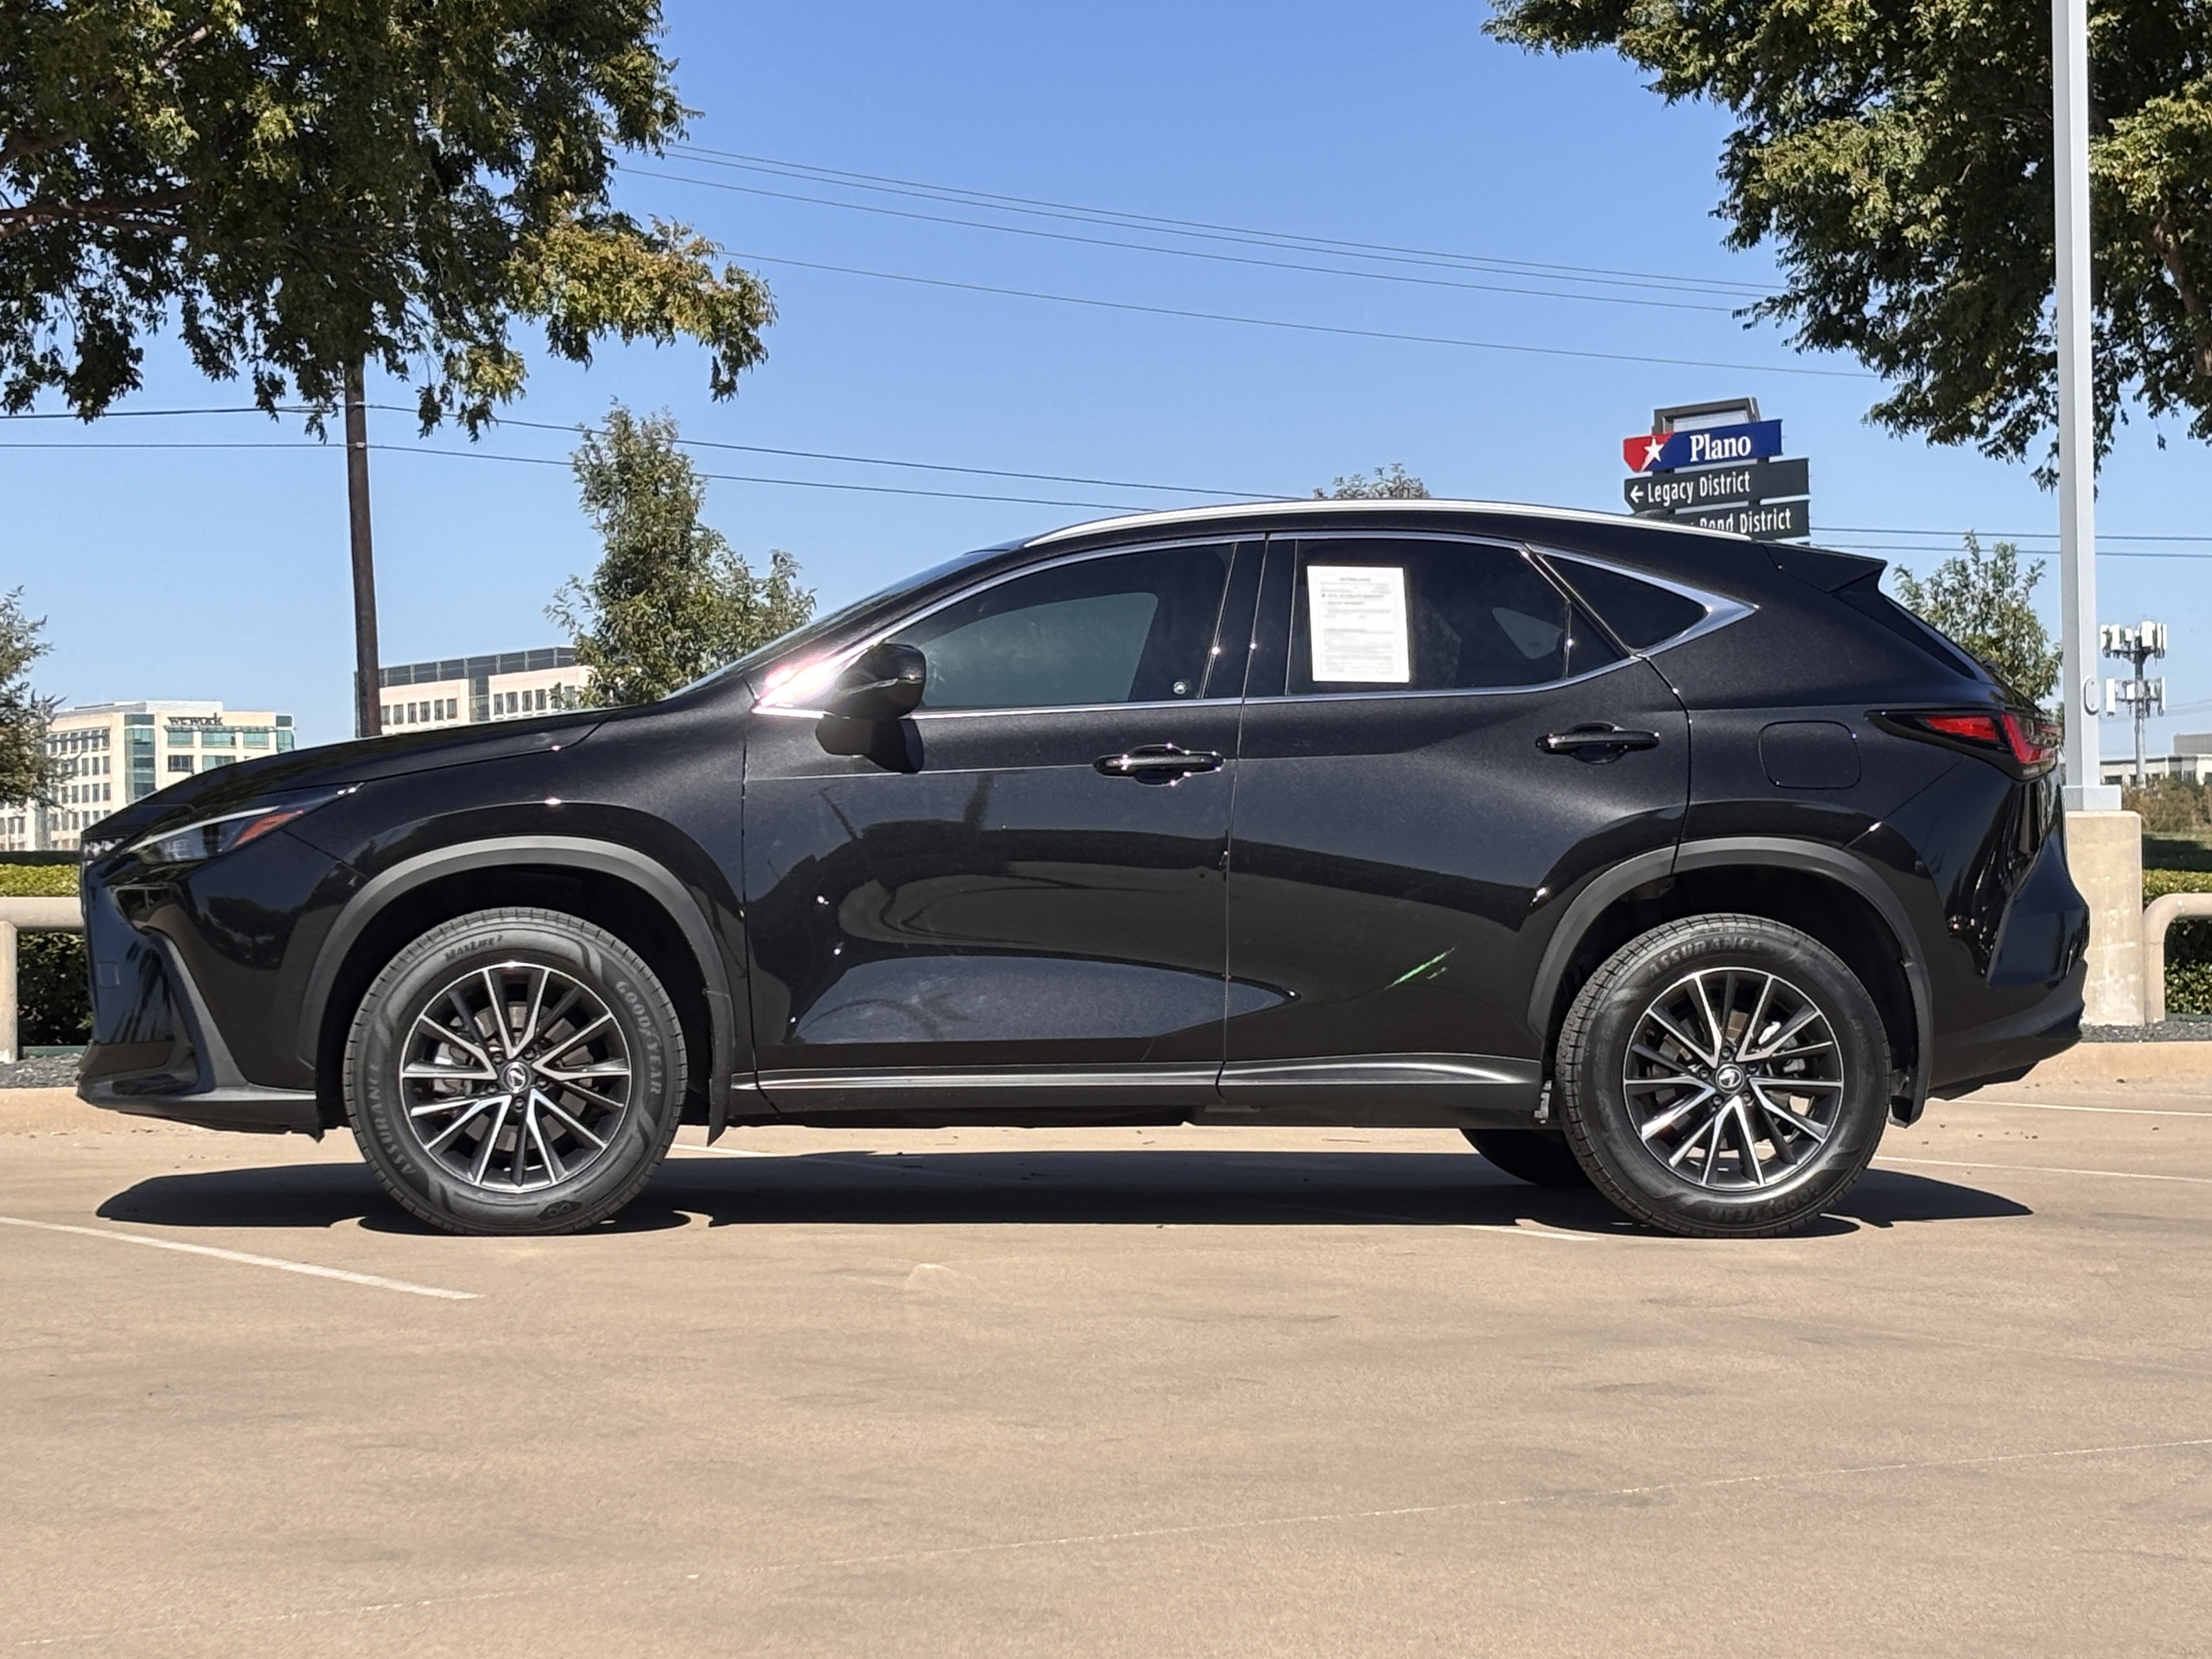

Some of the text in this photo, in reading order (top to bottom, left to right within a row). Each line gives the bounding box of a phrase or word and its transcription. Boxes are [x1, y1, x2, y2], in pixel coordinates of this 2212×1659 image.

[1689, 433, 1752, 462] Plano
[1647, 471, 1751, 507] Legacy District
[1740, 507, 1792, 534] District
[616, 981, 663, 1094] GOODYEAR
